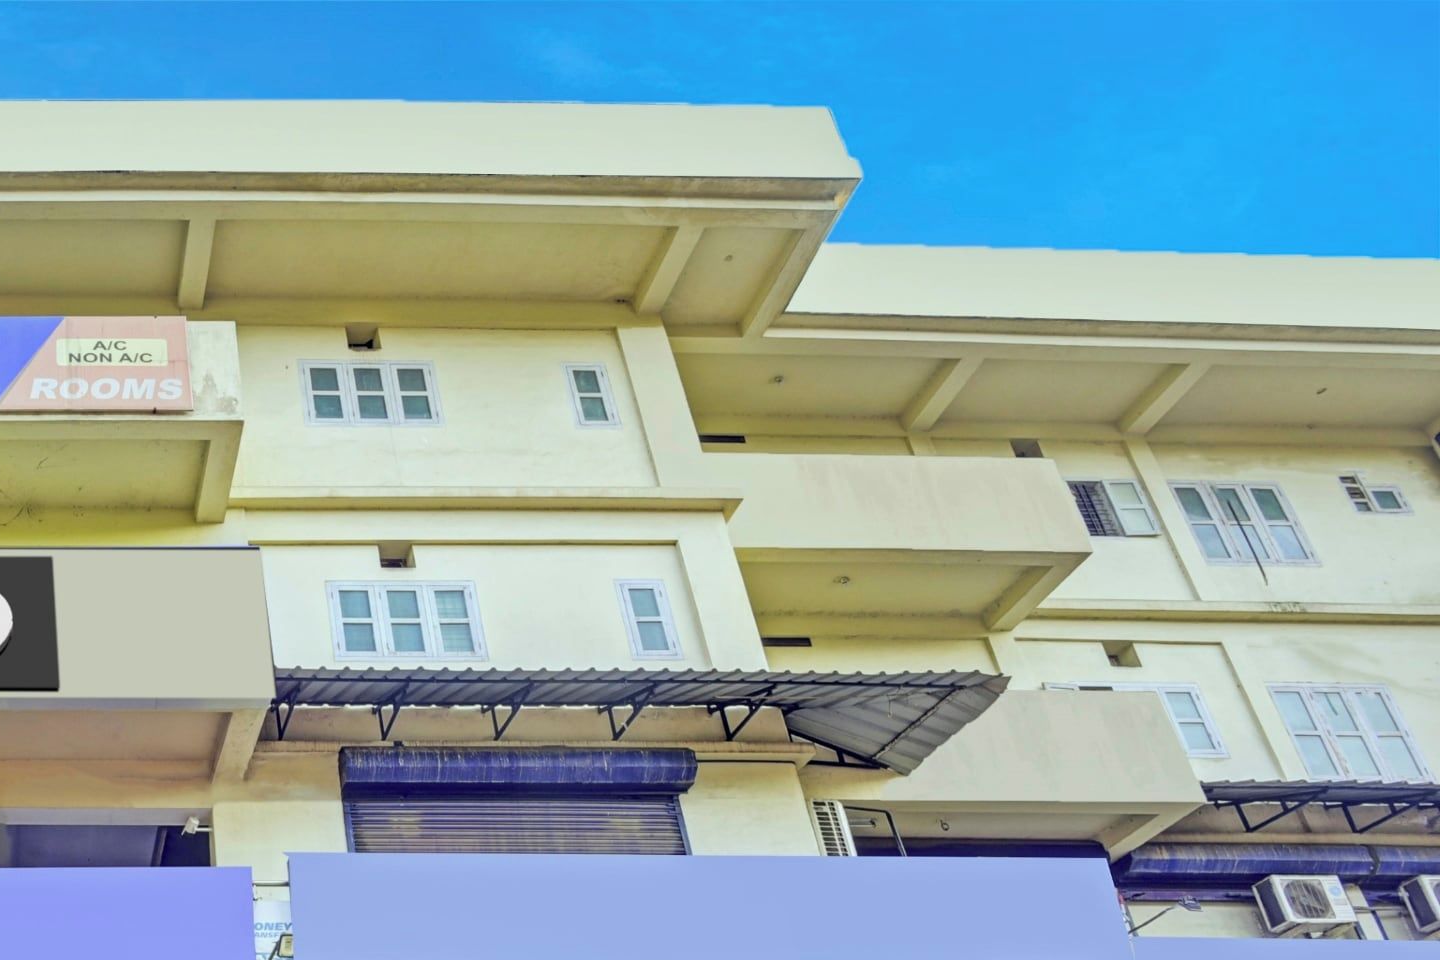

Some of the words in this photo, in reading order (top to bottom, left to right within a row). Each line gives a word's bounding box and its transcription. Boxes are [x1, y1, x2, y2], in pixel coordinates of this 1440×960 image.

[92, 340, 128, 351] A/C
[68, 353, 112, 364] NON
[120, 352, 153, 363] A/C
[29, 377, 184, 400] ROOMS
[254, 922, 293, 931] ONEY
